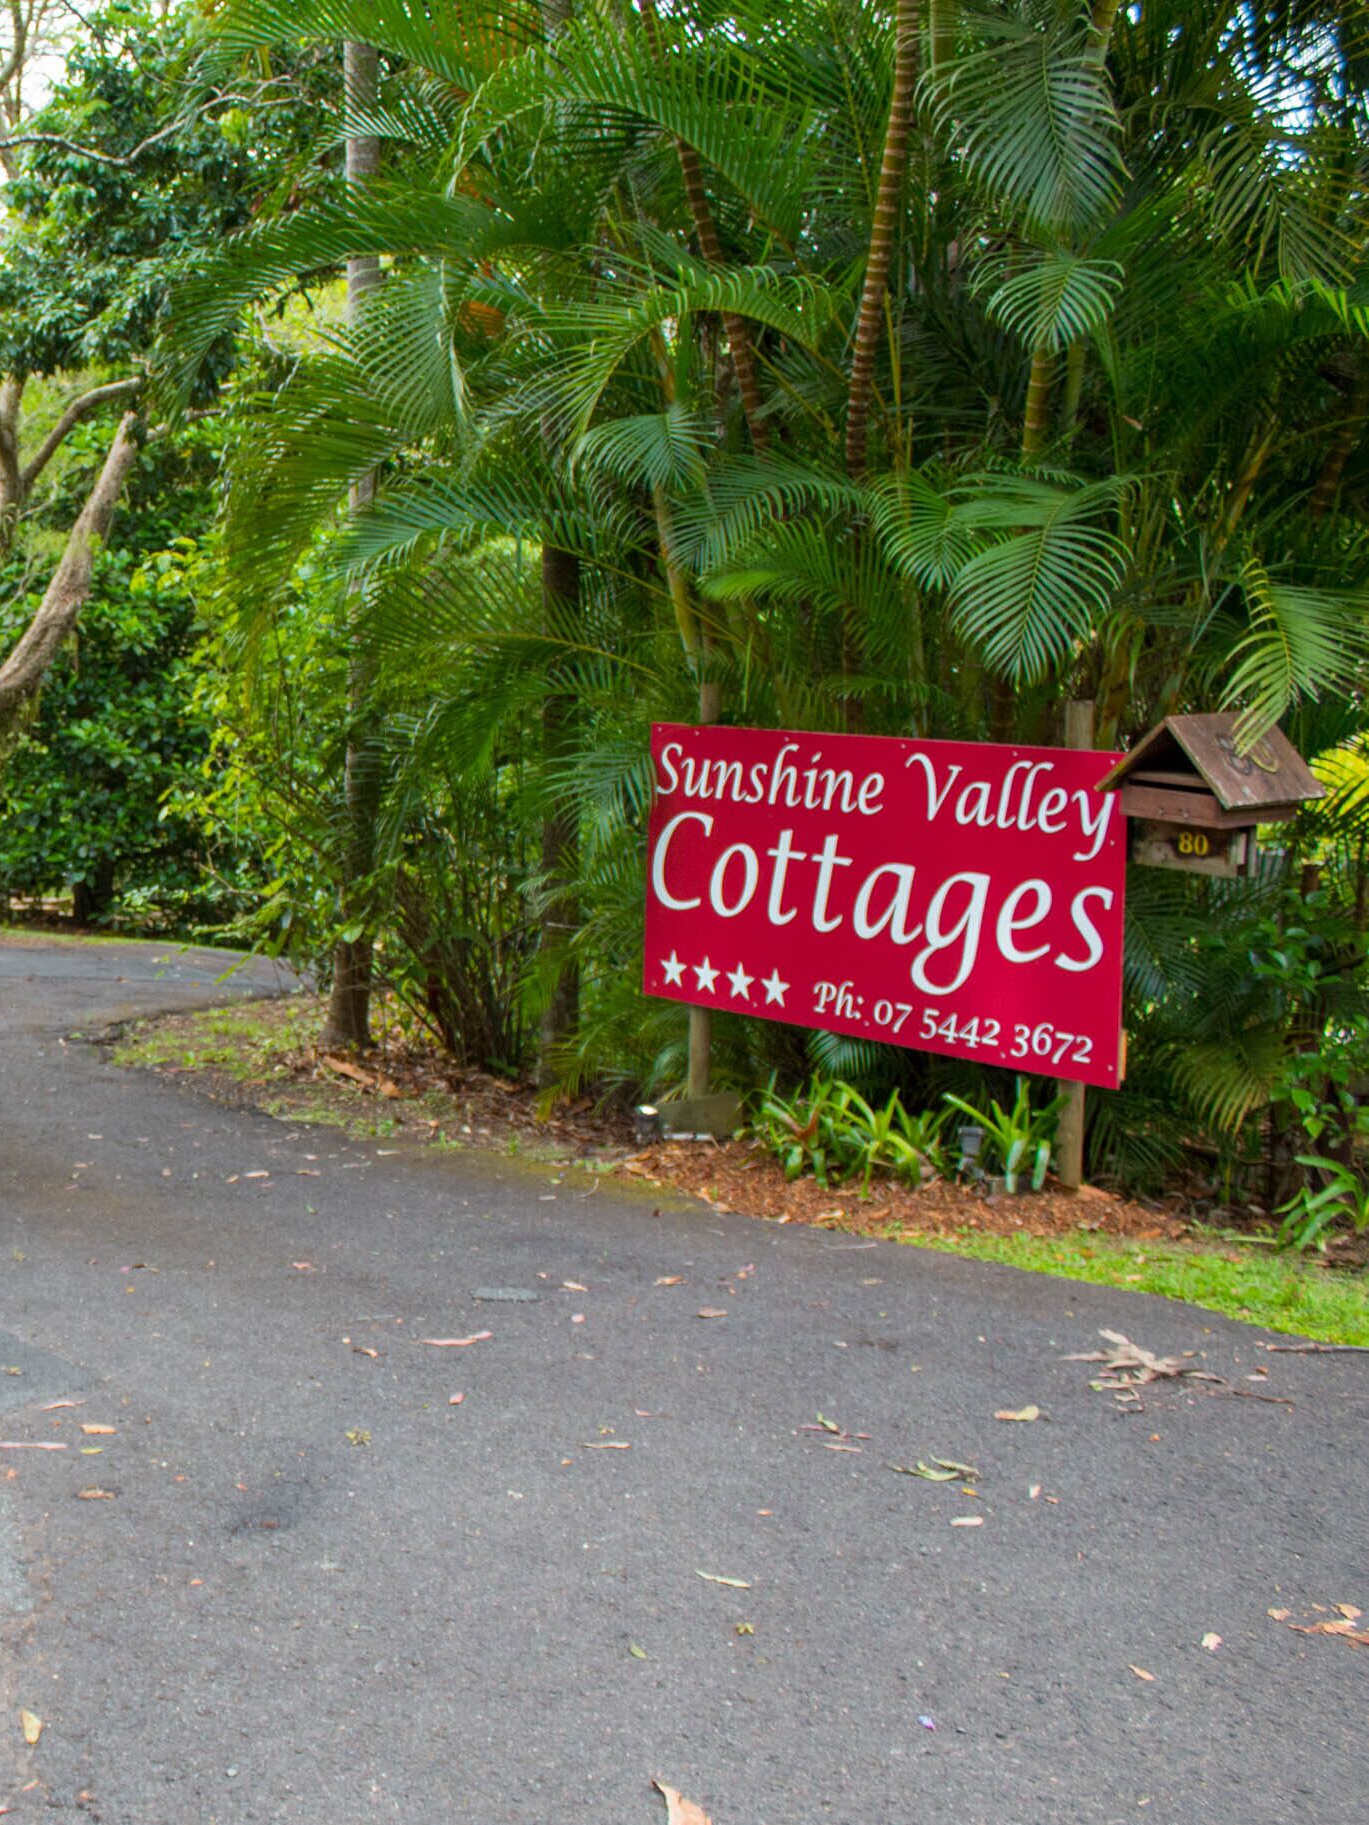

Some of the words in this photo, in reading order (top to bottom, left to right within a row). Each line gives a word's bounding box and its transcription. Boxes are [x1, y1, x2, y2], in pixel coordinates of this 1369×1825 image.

[655, 742, 885, 816] Sunshine
[905, 752, 1114, 862] Valley
[1178, 831, 1209, 855] 80
[652, 811, 1114, 996] Cottages
[813, 981, 864, 1020] Ph:
[873, 1000, 913, 1033] 07
[919, 1008, 1001, 1048] 5442
[1010, 1024, 1093, 1064] 3672
